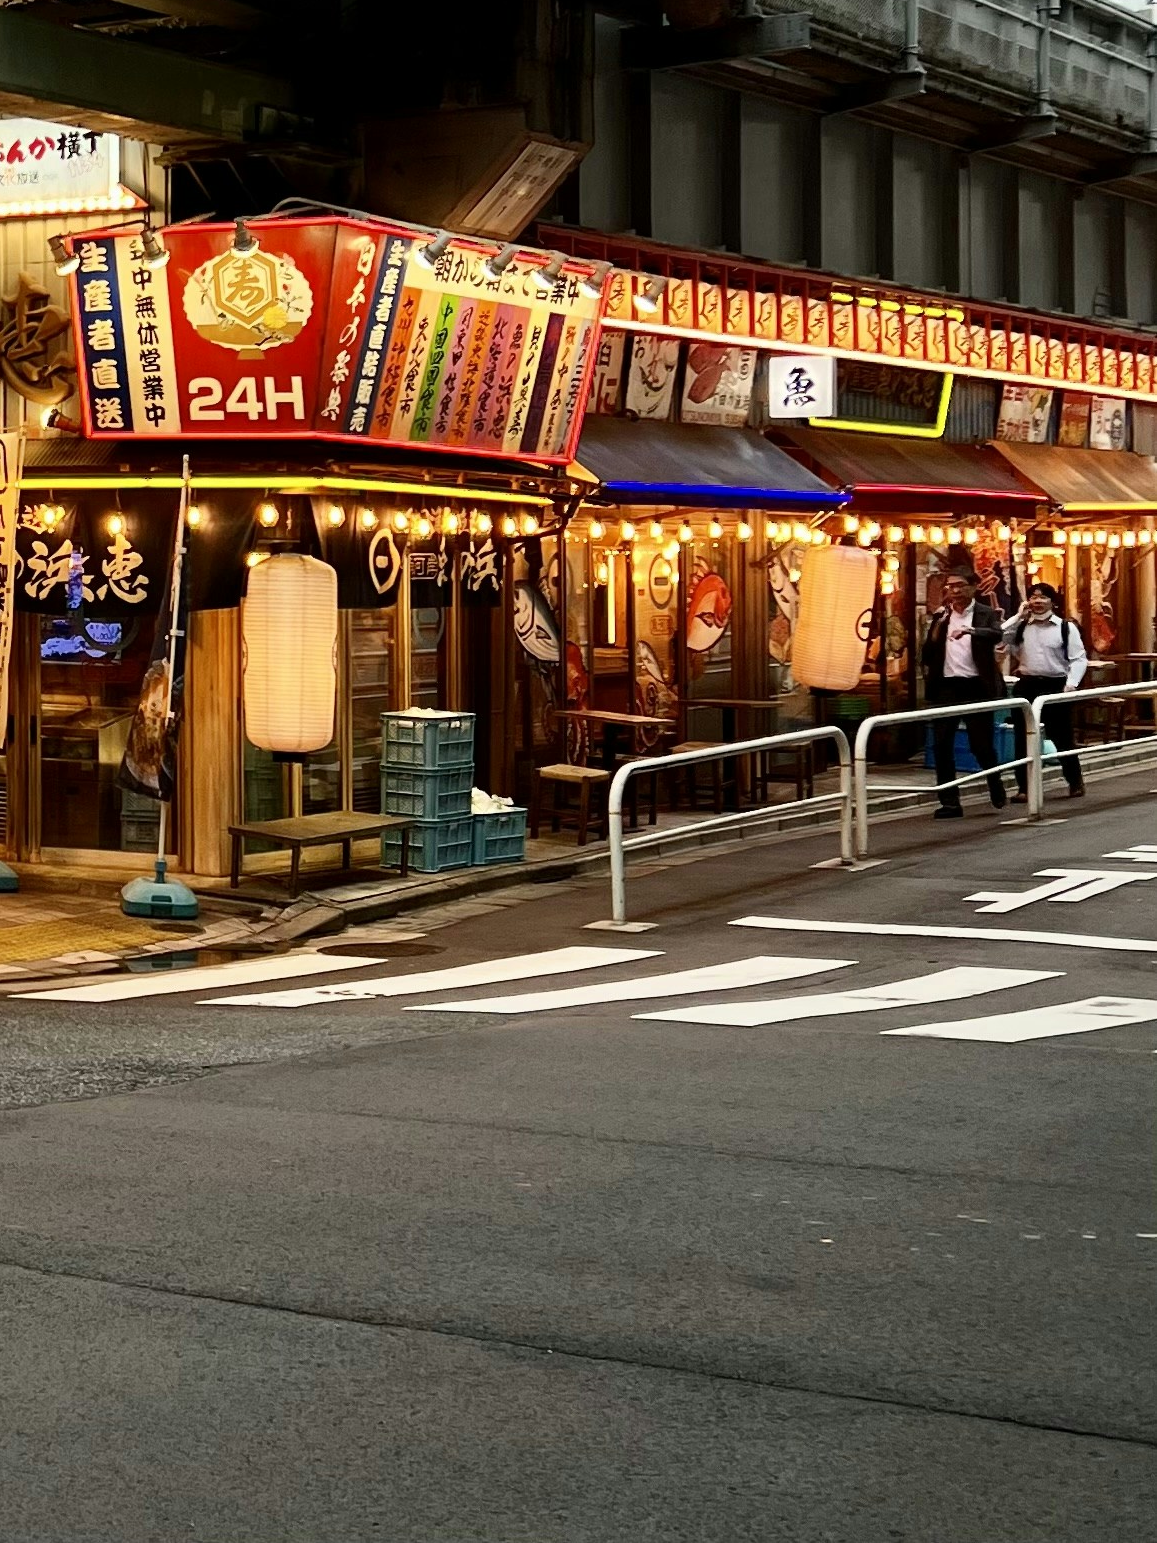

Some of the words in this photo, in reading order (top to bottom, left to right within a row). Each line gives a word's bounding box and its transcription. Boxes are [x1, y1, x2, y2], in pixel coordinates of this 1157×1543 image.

[79, 241, 125, 429] 生産者直送
[129, 239, 166, 428] 年中無休営業中
[225, 259, 259, 309] 寿
[349, 239, 406, 432] 生産者直結販売
[188, 375, 306, 422] 24H
[783, 366, 817, 407] 魚
